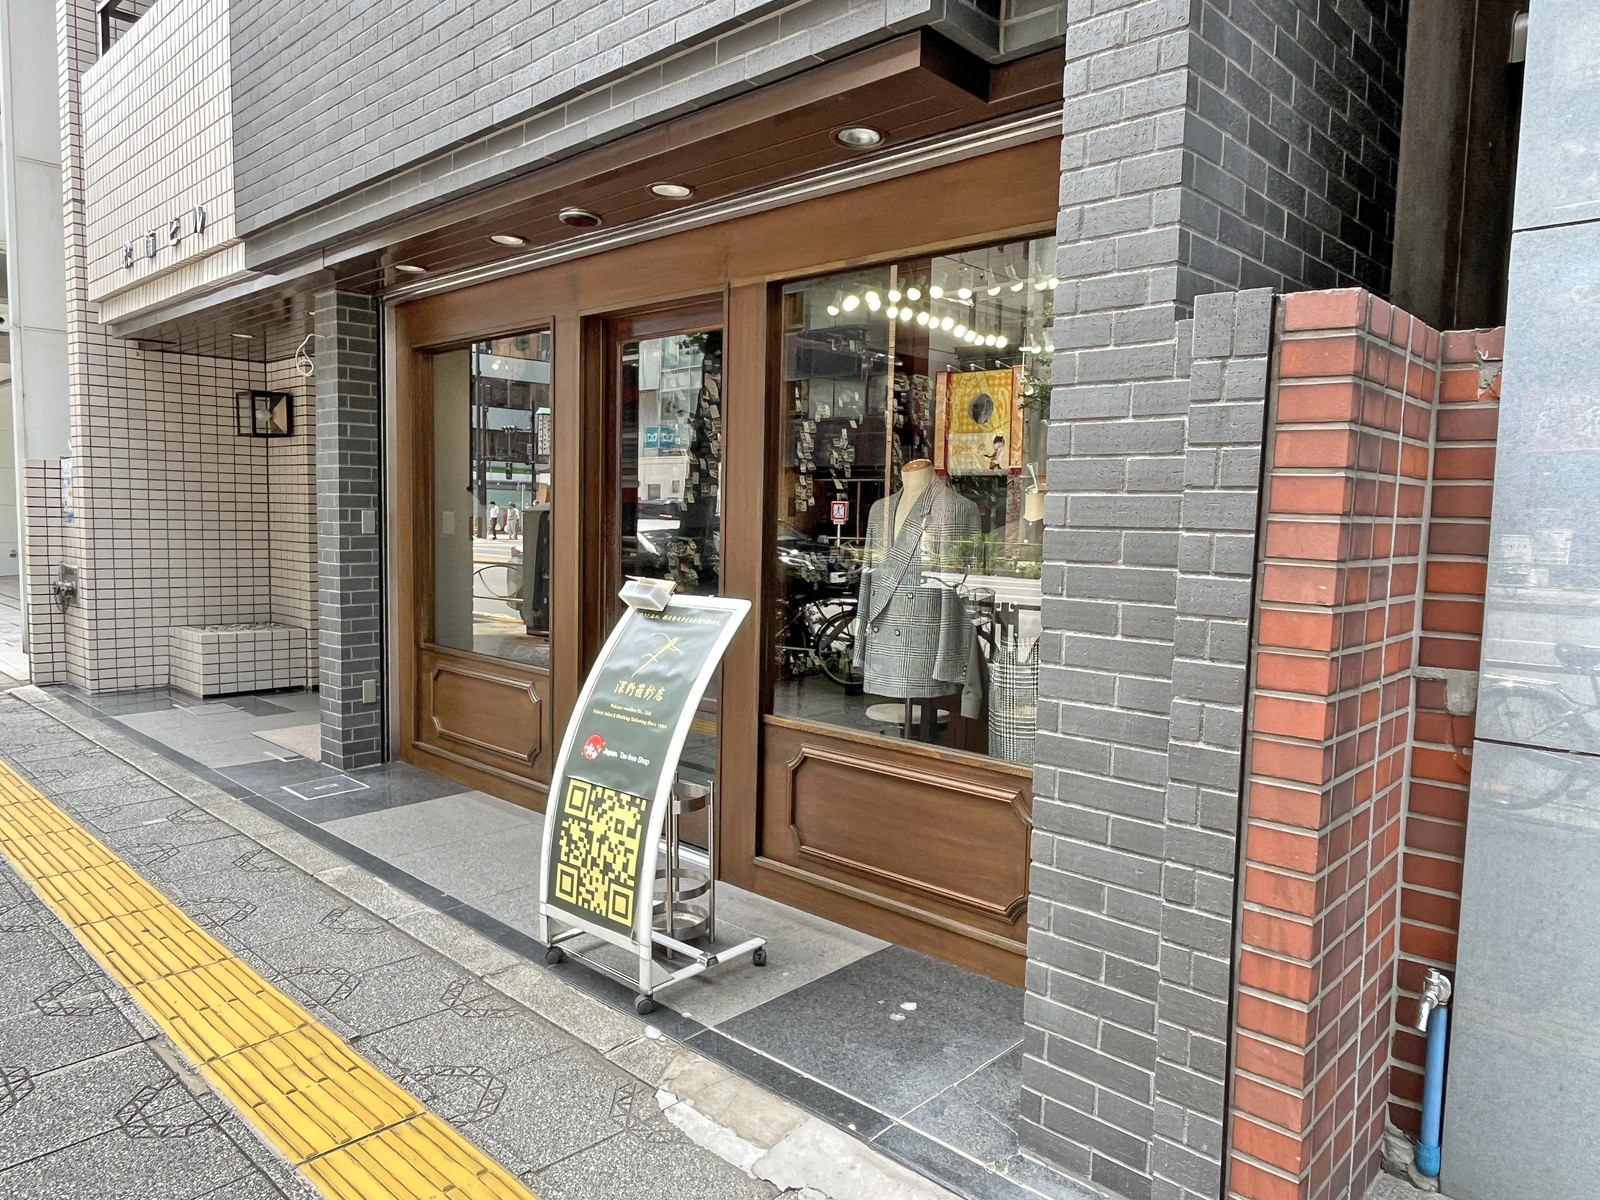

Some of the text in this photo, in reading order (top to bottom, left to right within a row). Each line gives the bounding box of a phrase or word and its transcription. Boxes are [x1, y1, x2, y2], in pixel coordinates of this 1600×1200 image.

[614, 680, 665, 701] 深野羅紗店
[620, 751, 638, 762] Tax-free
[637, 755, 651, 767] Shop
